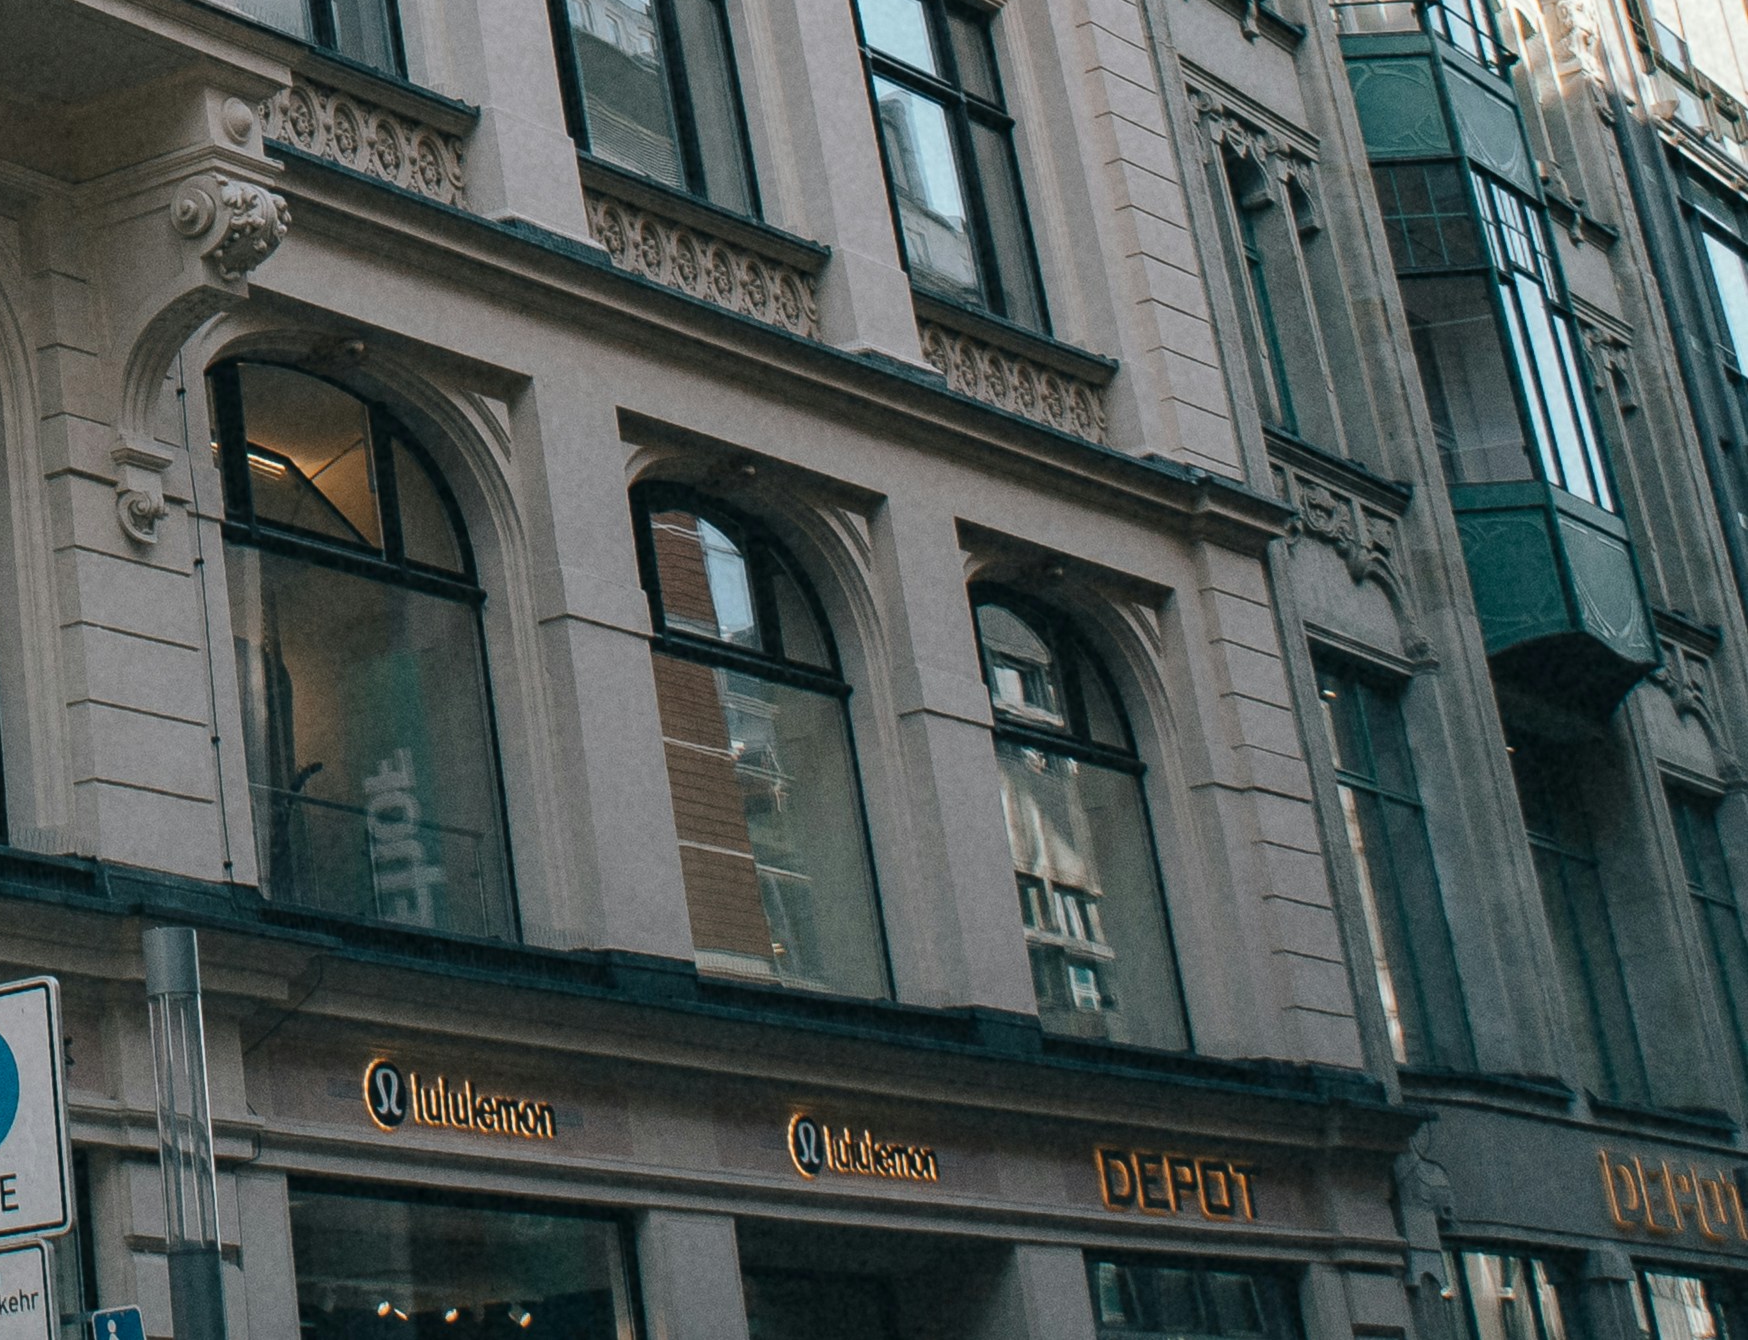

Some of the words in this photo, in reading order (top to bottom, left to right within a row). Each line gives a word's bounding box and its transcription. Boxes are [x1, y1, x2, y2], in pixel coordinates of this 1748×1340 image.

[410, 1072, 557, 1140] lululemon
[823, 1124, 940, 1183] lululemon
[1094, 1145, 1260, 1222] DEPOT
